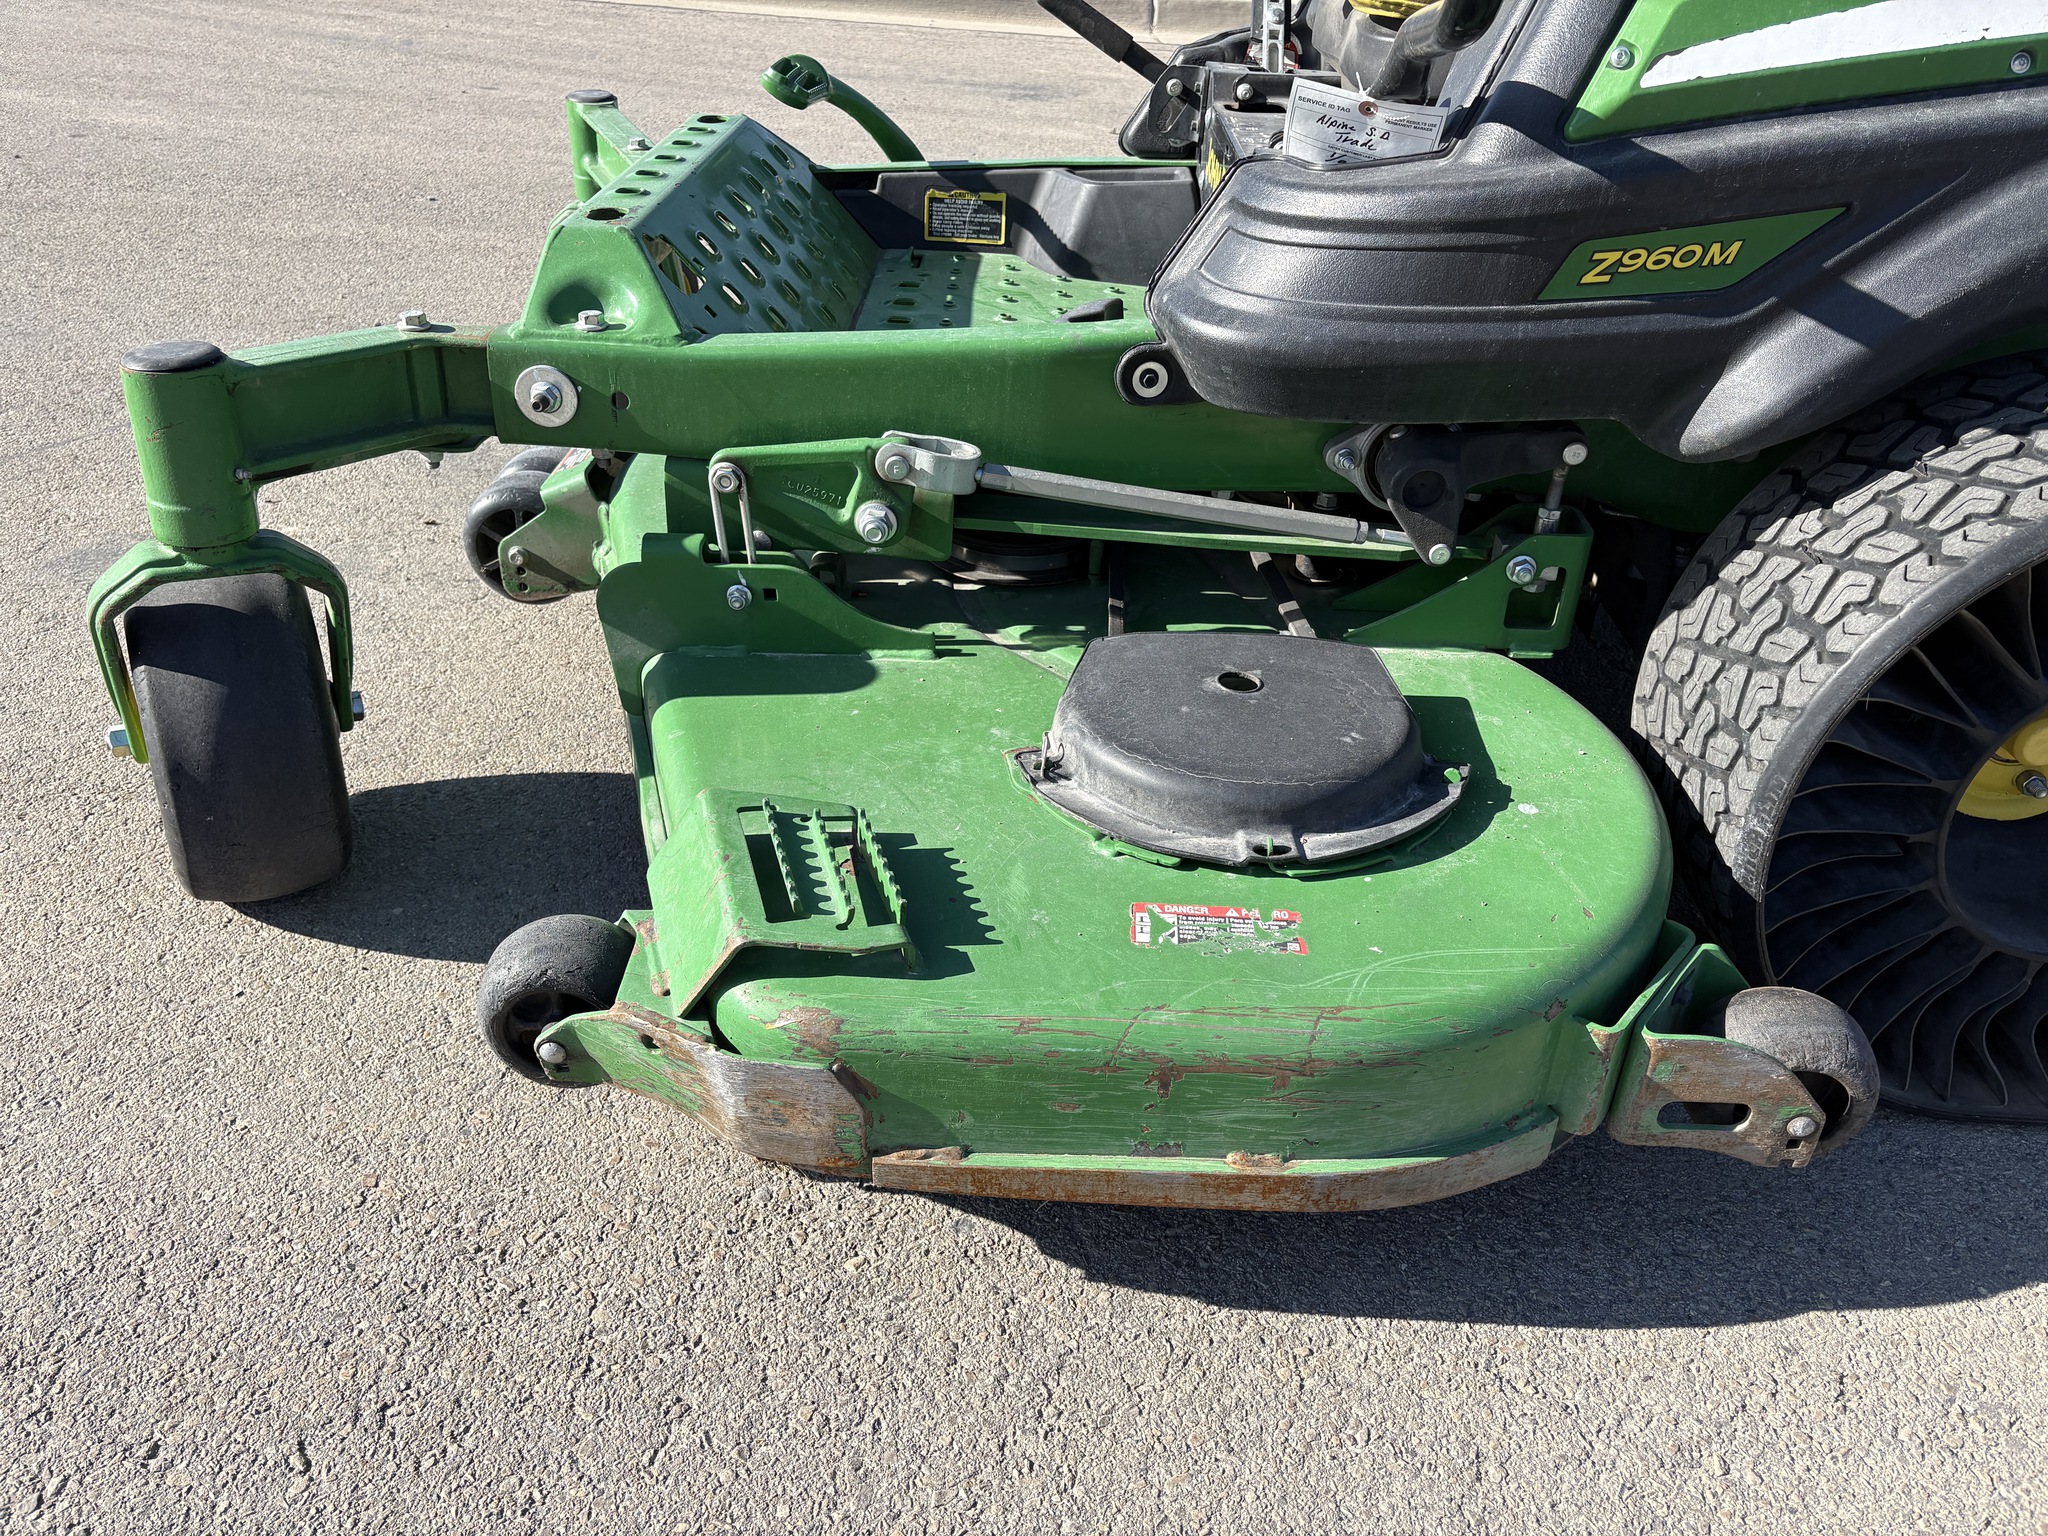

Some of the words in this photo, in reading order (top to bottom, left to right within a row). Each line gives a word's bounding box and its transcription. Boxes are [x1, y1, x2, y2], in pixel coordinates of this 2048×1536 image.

[1298, 95, 1328, 108] SERVICE
[1336, 104, 1351, 113] TAG
[1316, 114, 1356, 131] Alpine
[1384, 119, 1413, 129] PERMANENT
[1406, 119, 1427, 127] RESULTS
[1335, 131, 1377, 151] Trade
[1579, 239, 1745, 285] Z960M
[893, 465, 900, 474] F
[1164, 904, 1209, 914] DANGER
